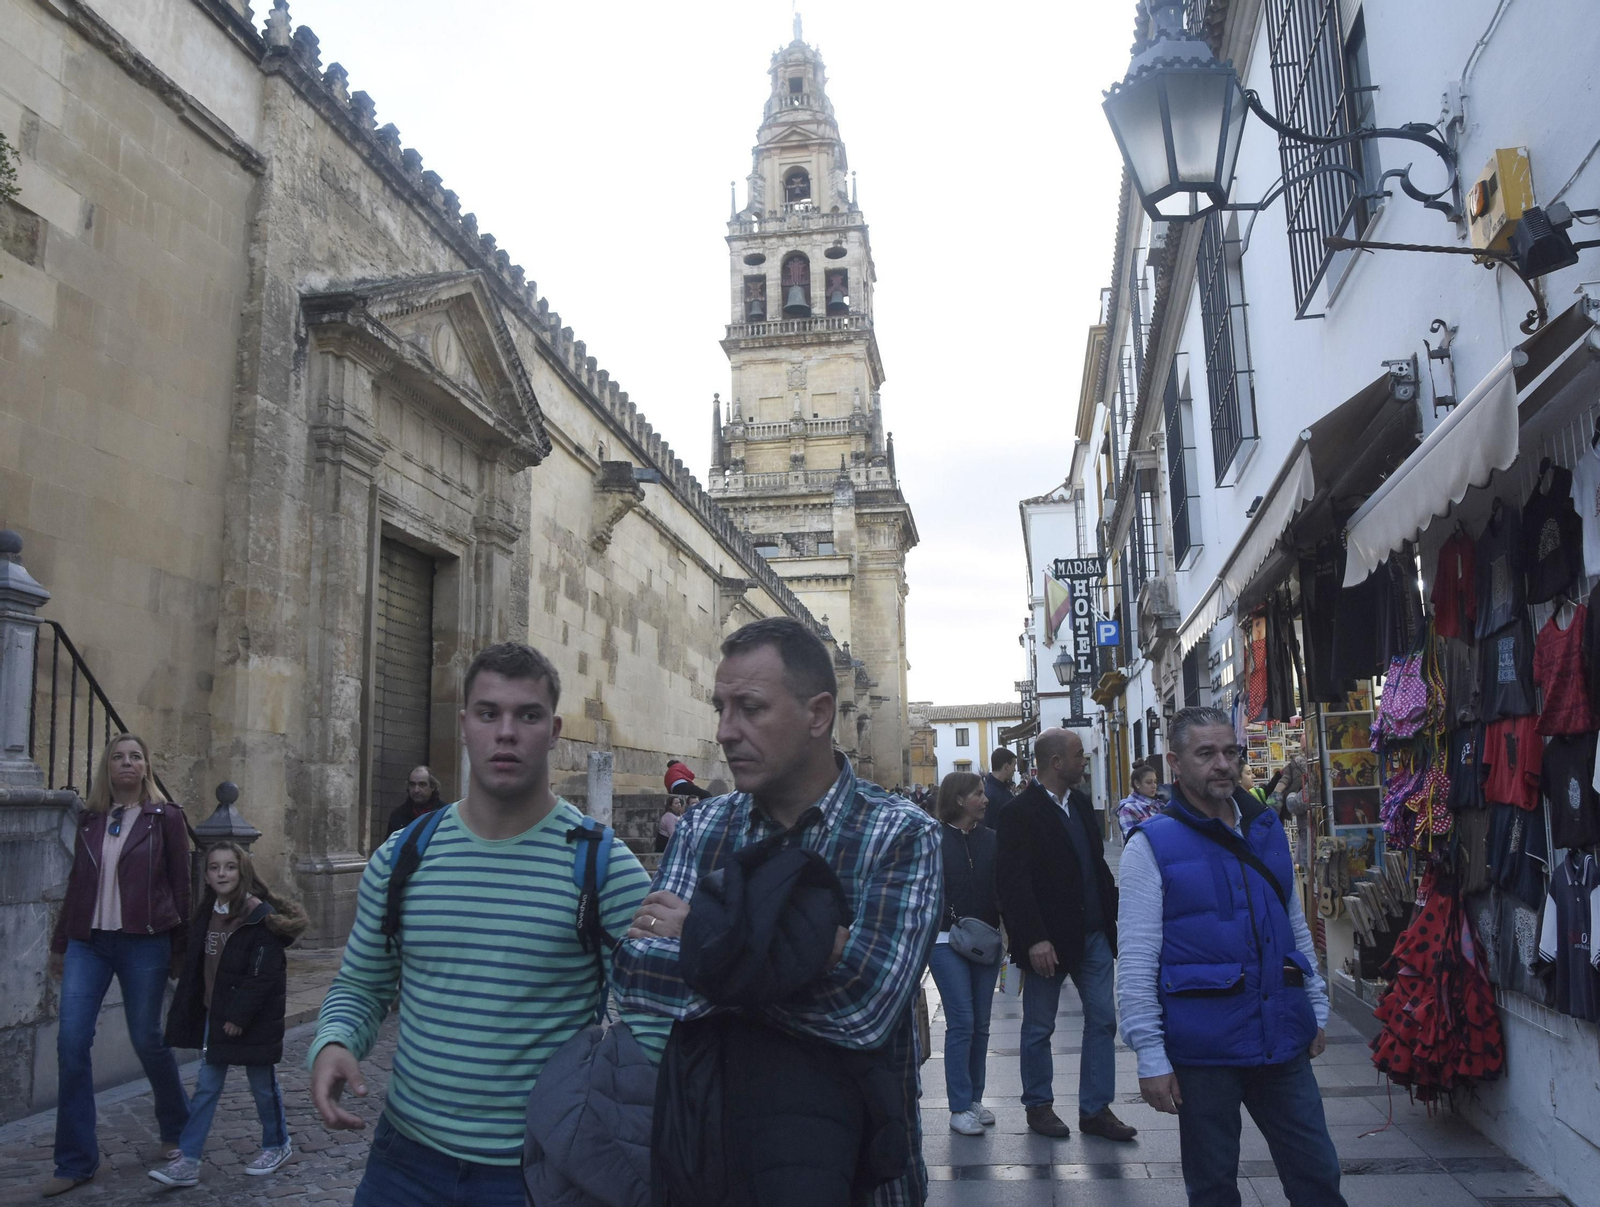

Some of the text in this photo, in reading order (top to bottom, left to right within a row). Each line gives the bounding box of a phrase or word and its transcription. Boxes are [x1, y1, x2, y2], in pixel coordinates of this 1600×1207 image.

[1056, 560, 1102, 576] MARISA
[1073, 579, 1091, 673] HOTEL
[1100, 624, 1116, 643] P
